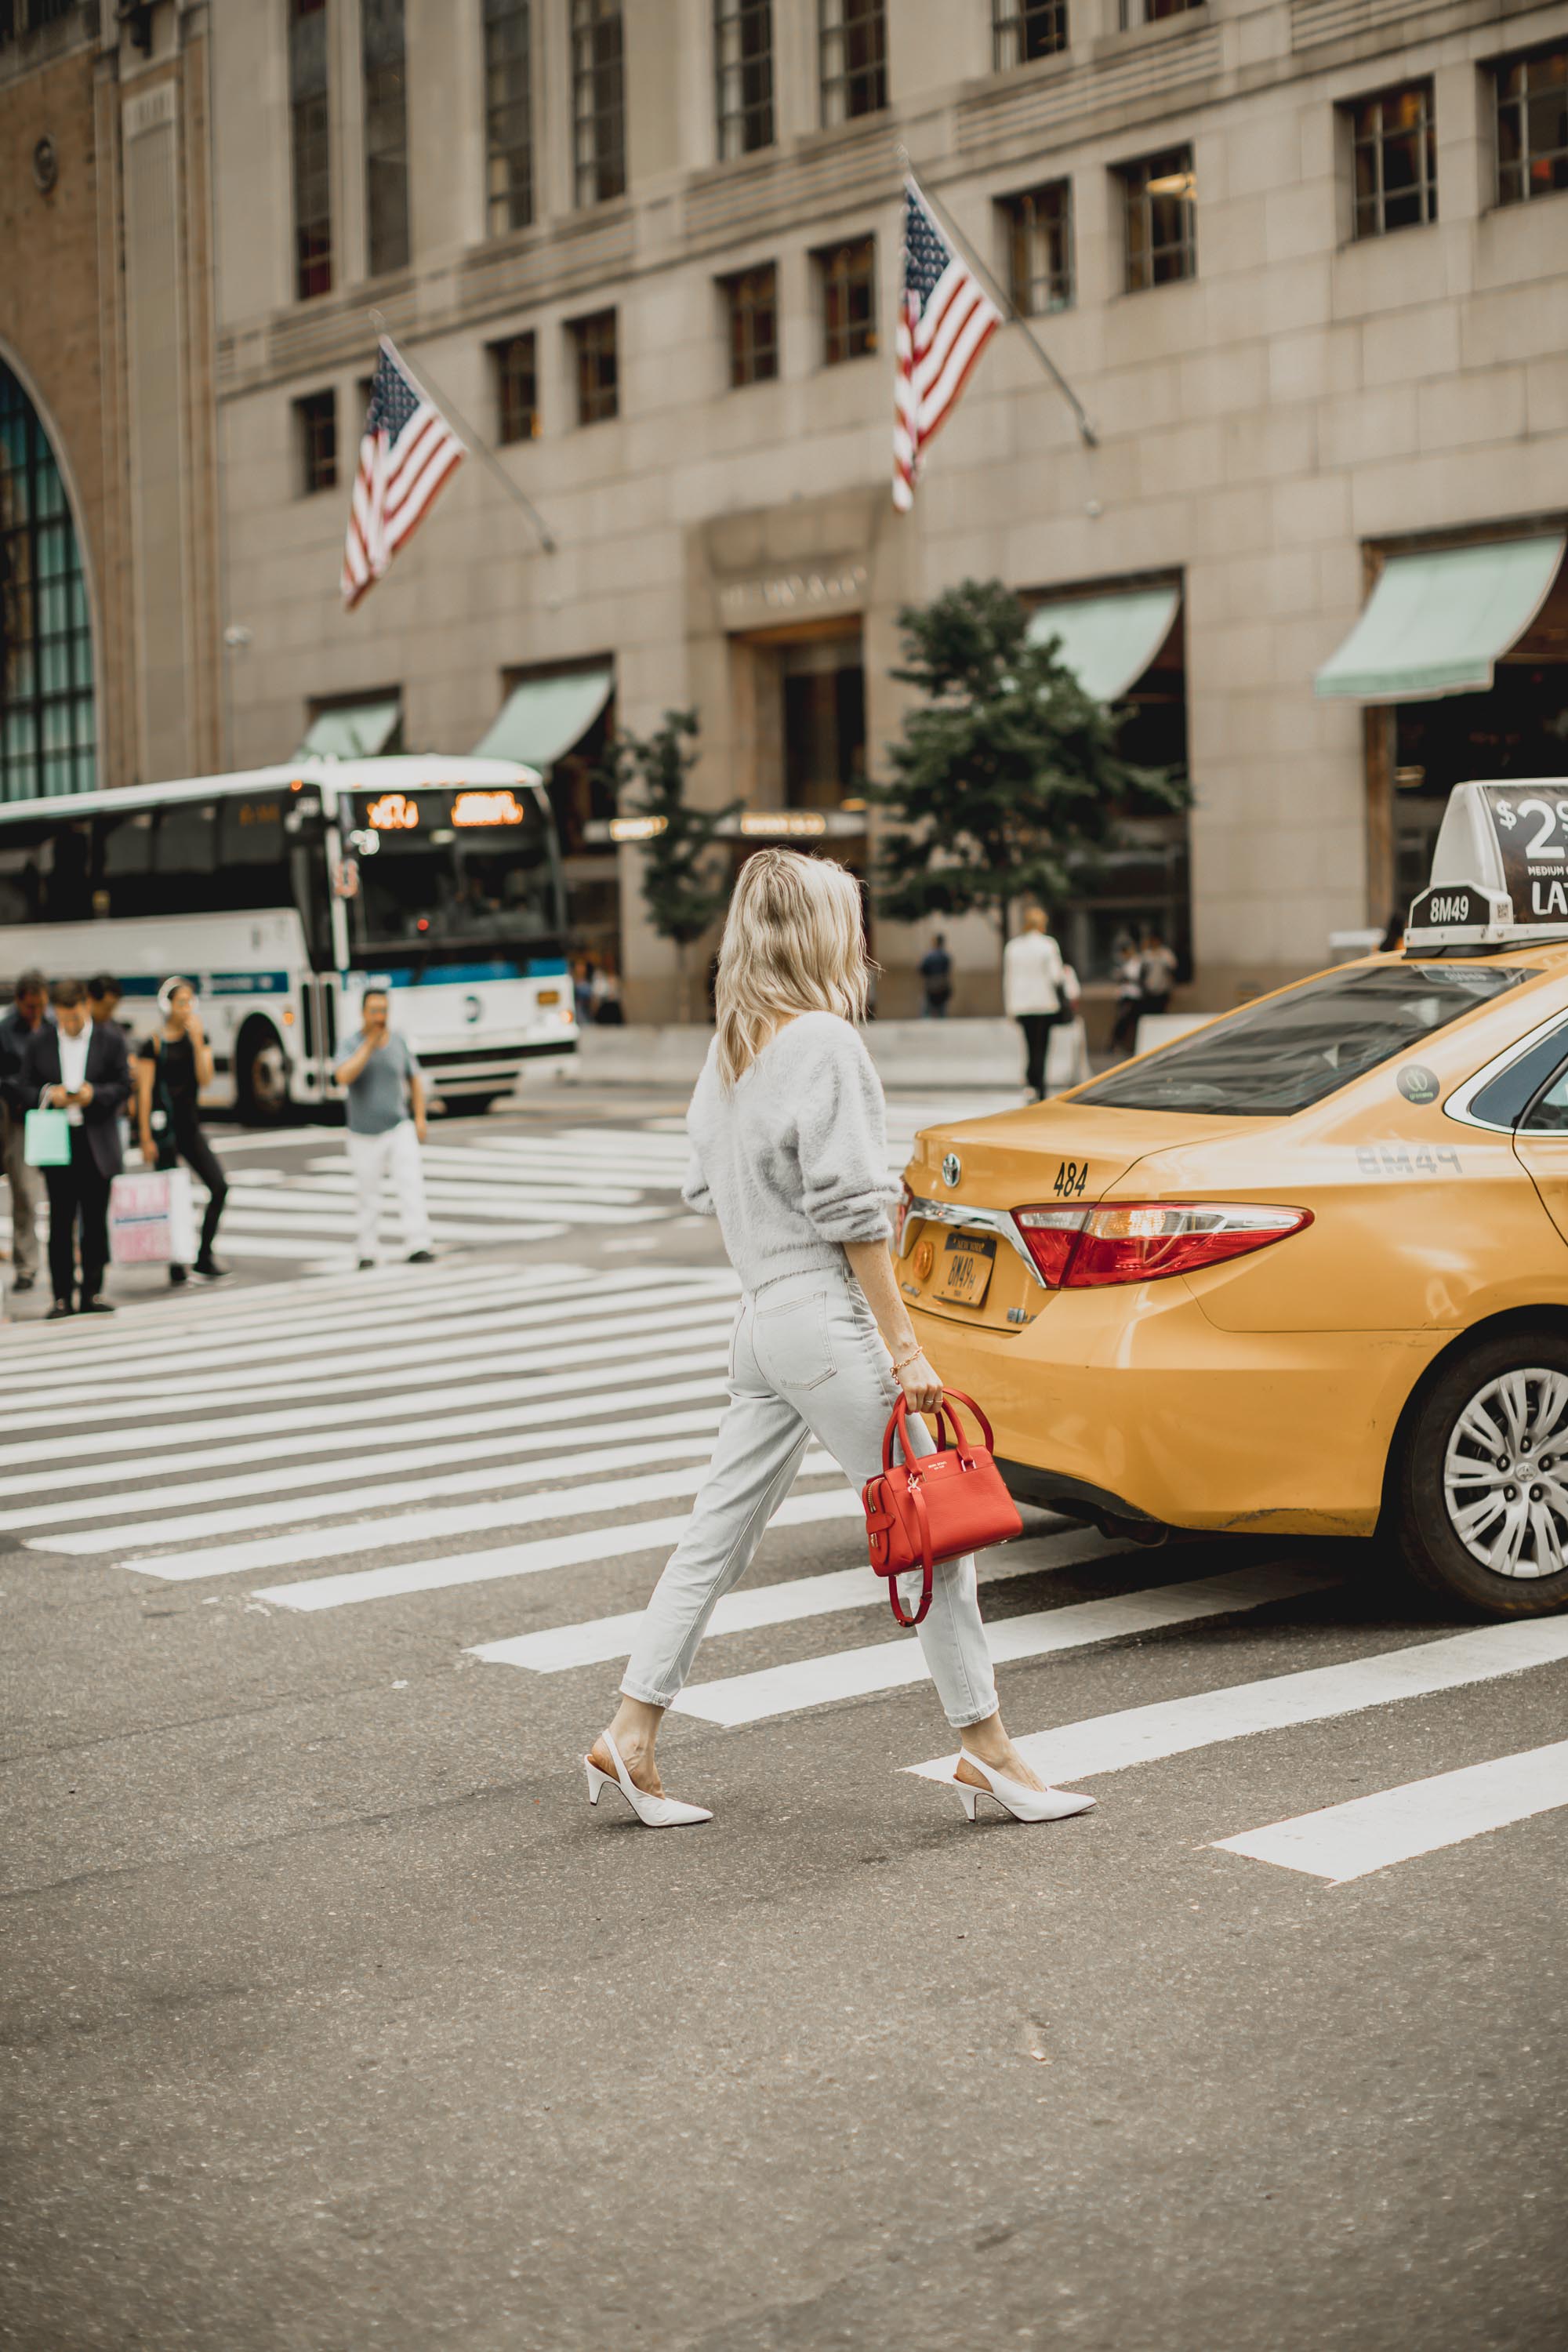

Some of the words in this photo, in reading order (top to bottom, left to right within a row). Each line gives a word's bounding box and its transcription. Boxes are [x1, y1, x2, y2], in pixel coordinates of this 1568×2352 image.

[1527, 866, 1564, 877] MEDIUM
[1429, 895, 1469, 922] 8M49
[1355, 1145, 1463, 1174] 8M49
[1054, 1162, 1088, 1197] 484
